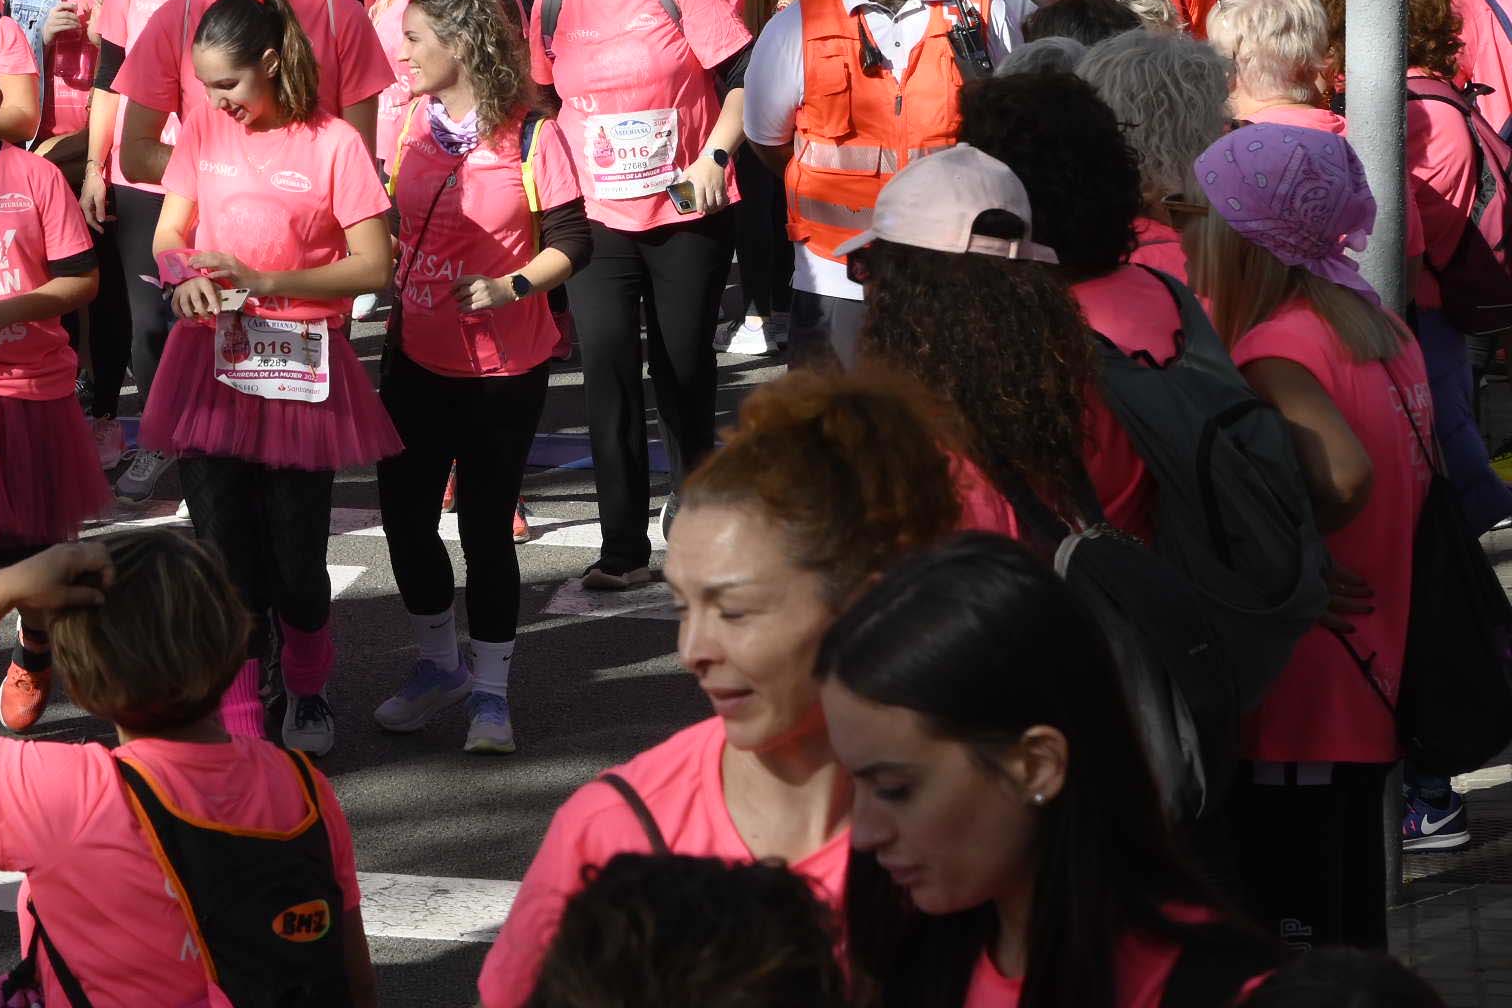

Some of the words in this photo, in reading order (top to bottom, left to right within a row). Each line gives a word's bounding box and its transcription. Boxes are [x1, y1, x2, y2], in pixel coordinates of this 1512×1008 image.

[618, 145, 650, 160] 016
[253, 341, 292, 355] 016
[228, 370, 258, 378] CARRERA
[259, 370, 268, 378] DE
